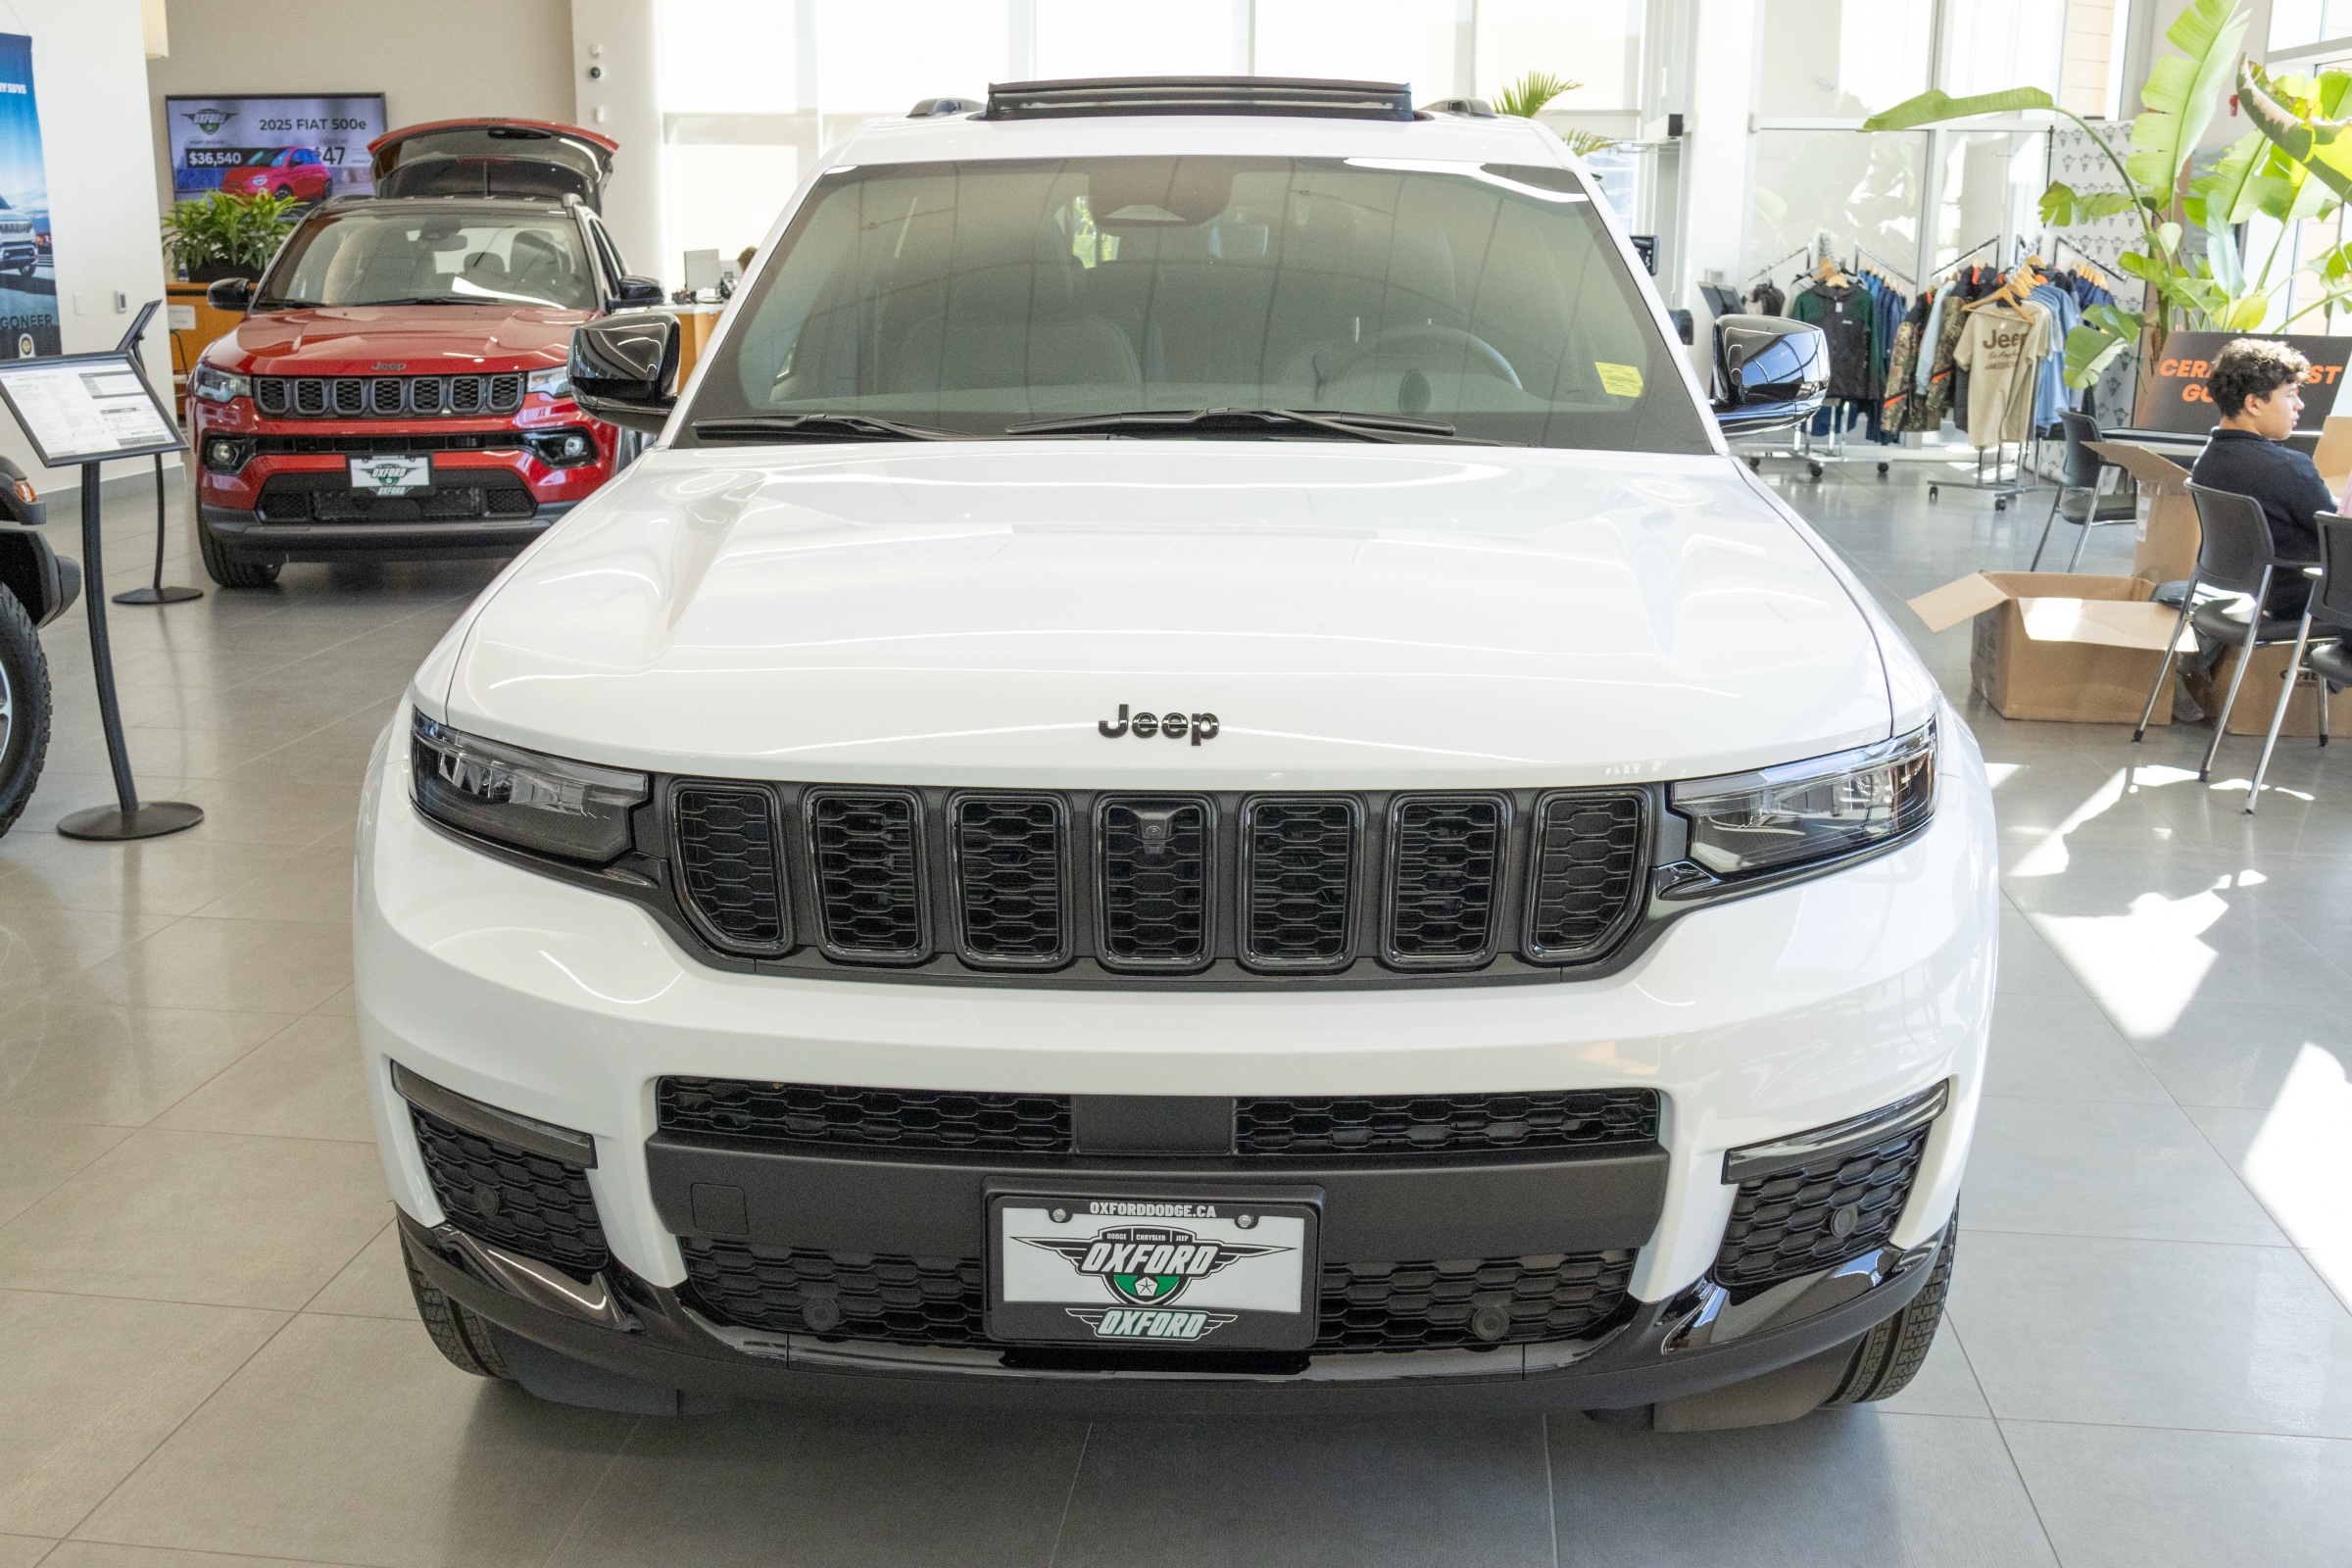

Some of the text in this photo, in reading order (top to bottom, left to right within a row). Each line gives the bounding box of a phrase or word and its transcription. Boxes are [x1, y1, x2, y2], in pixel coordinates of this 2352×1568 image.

[260, 118, 367, 130] 2025 FIAT 500e
[188, 151, 242, 167] $36,540
[315, 146, 345, 166] $47
[370, 361, 407, 371] Jeep
[371, 467, 408, 478] OXFORD
[377, 486, 406, 496] OXFORD
[1098, 704, 1219, 747] Jeep
[1089, 1201, 1216, 1218] OXFORDDODGE.CA
[1136, 1233, 1166, 1242] CHRYSLER
[1081, 1243, 1218, 1274] OXFORD
[1097, 1310, 1207, 1338] OXFORD
